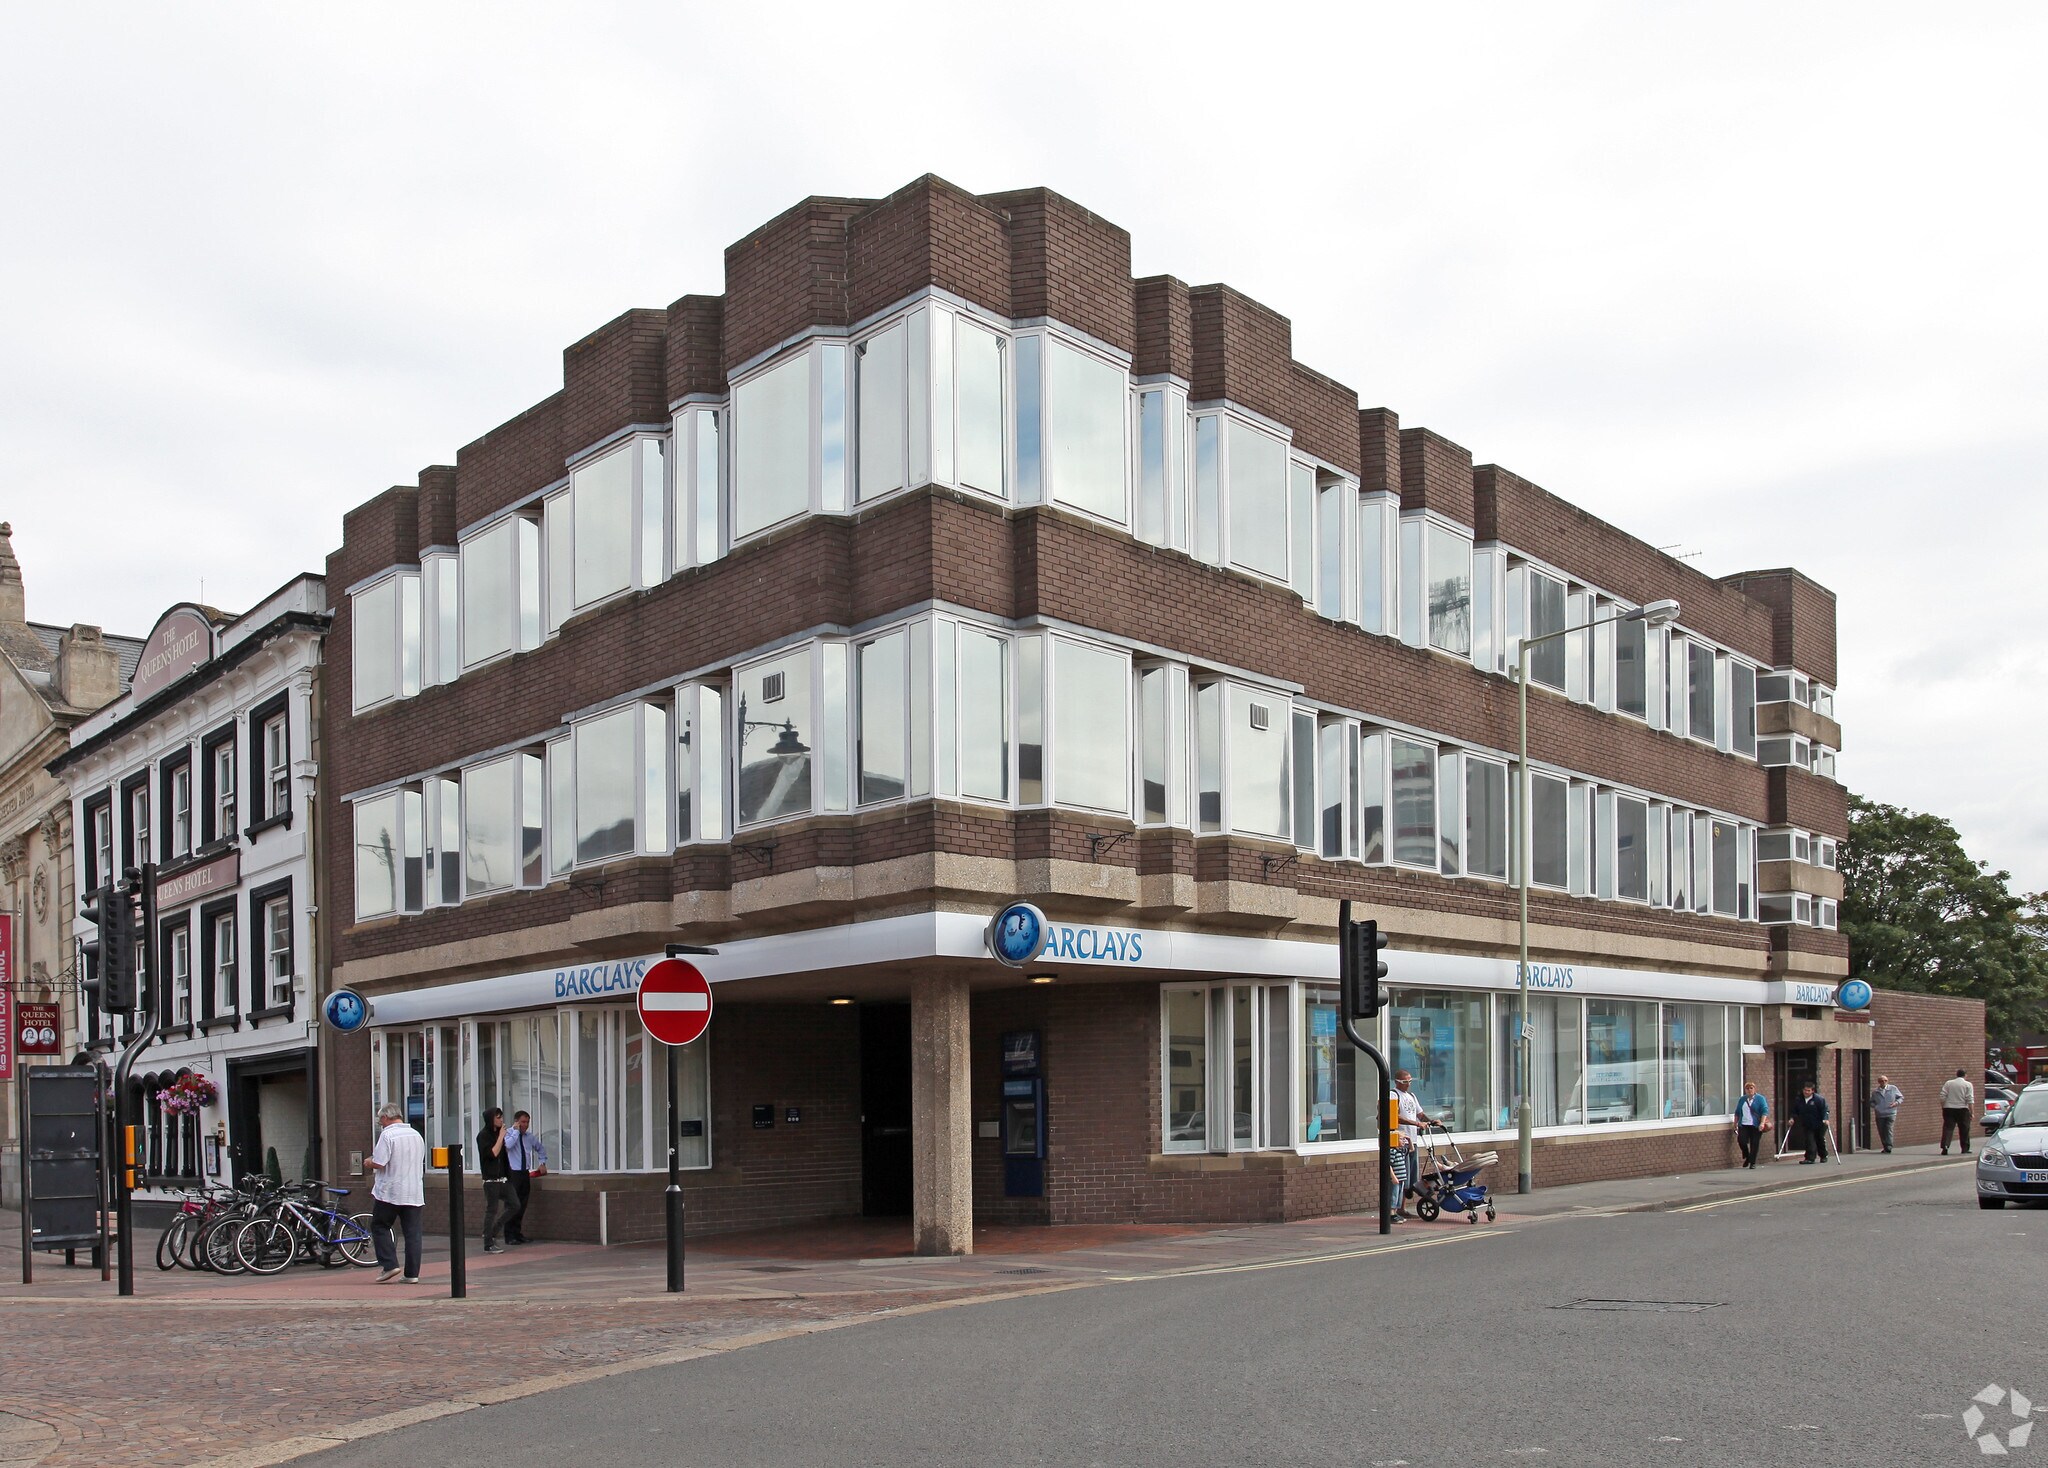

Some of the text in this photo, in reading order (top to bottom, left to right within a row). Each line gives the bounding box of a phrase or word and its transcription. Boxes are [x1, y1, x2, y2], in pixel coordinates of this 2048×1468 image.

[163, 627, 176, 647] THE
[141, 629, 200, 684] QUEENS HOTEL
[157, 867, 213, 901] UEENS HOTEL
[1040, 926, 1142, 962] ARCLAYS
[555, 959, 647, 998] BARCLAYS
[1795, 985, 1829, 1003] BARCLAYS
[21, 1011, 56, 1020] QUEENS
[24, 1019, 53, 1027] HOTEL
[2027, 1172, 2048, 1181] RO6
